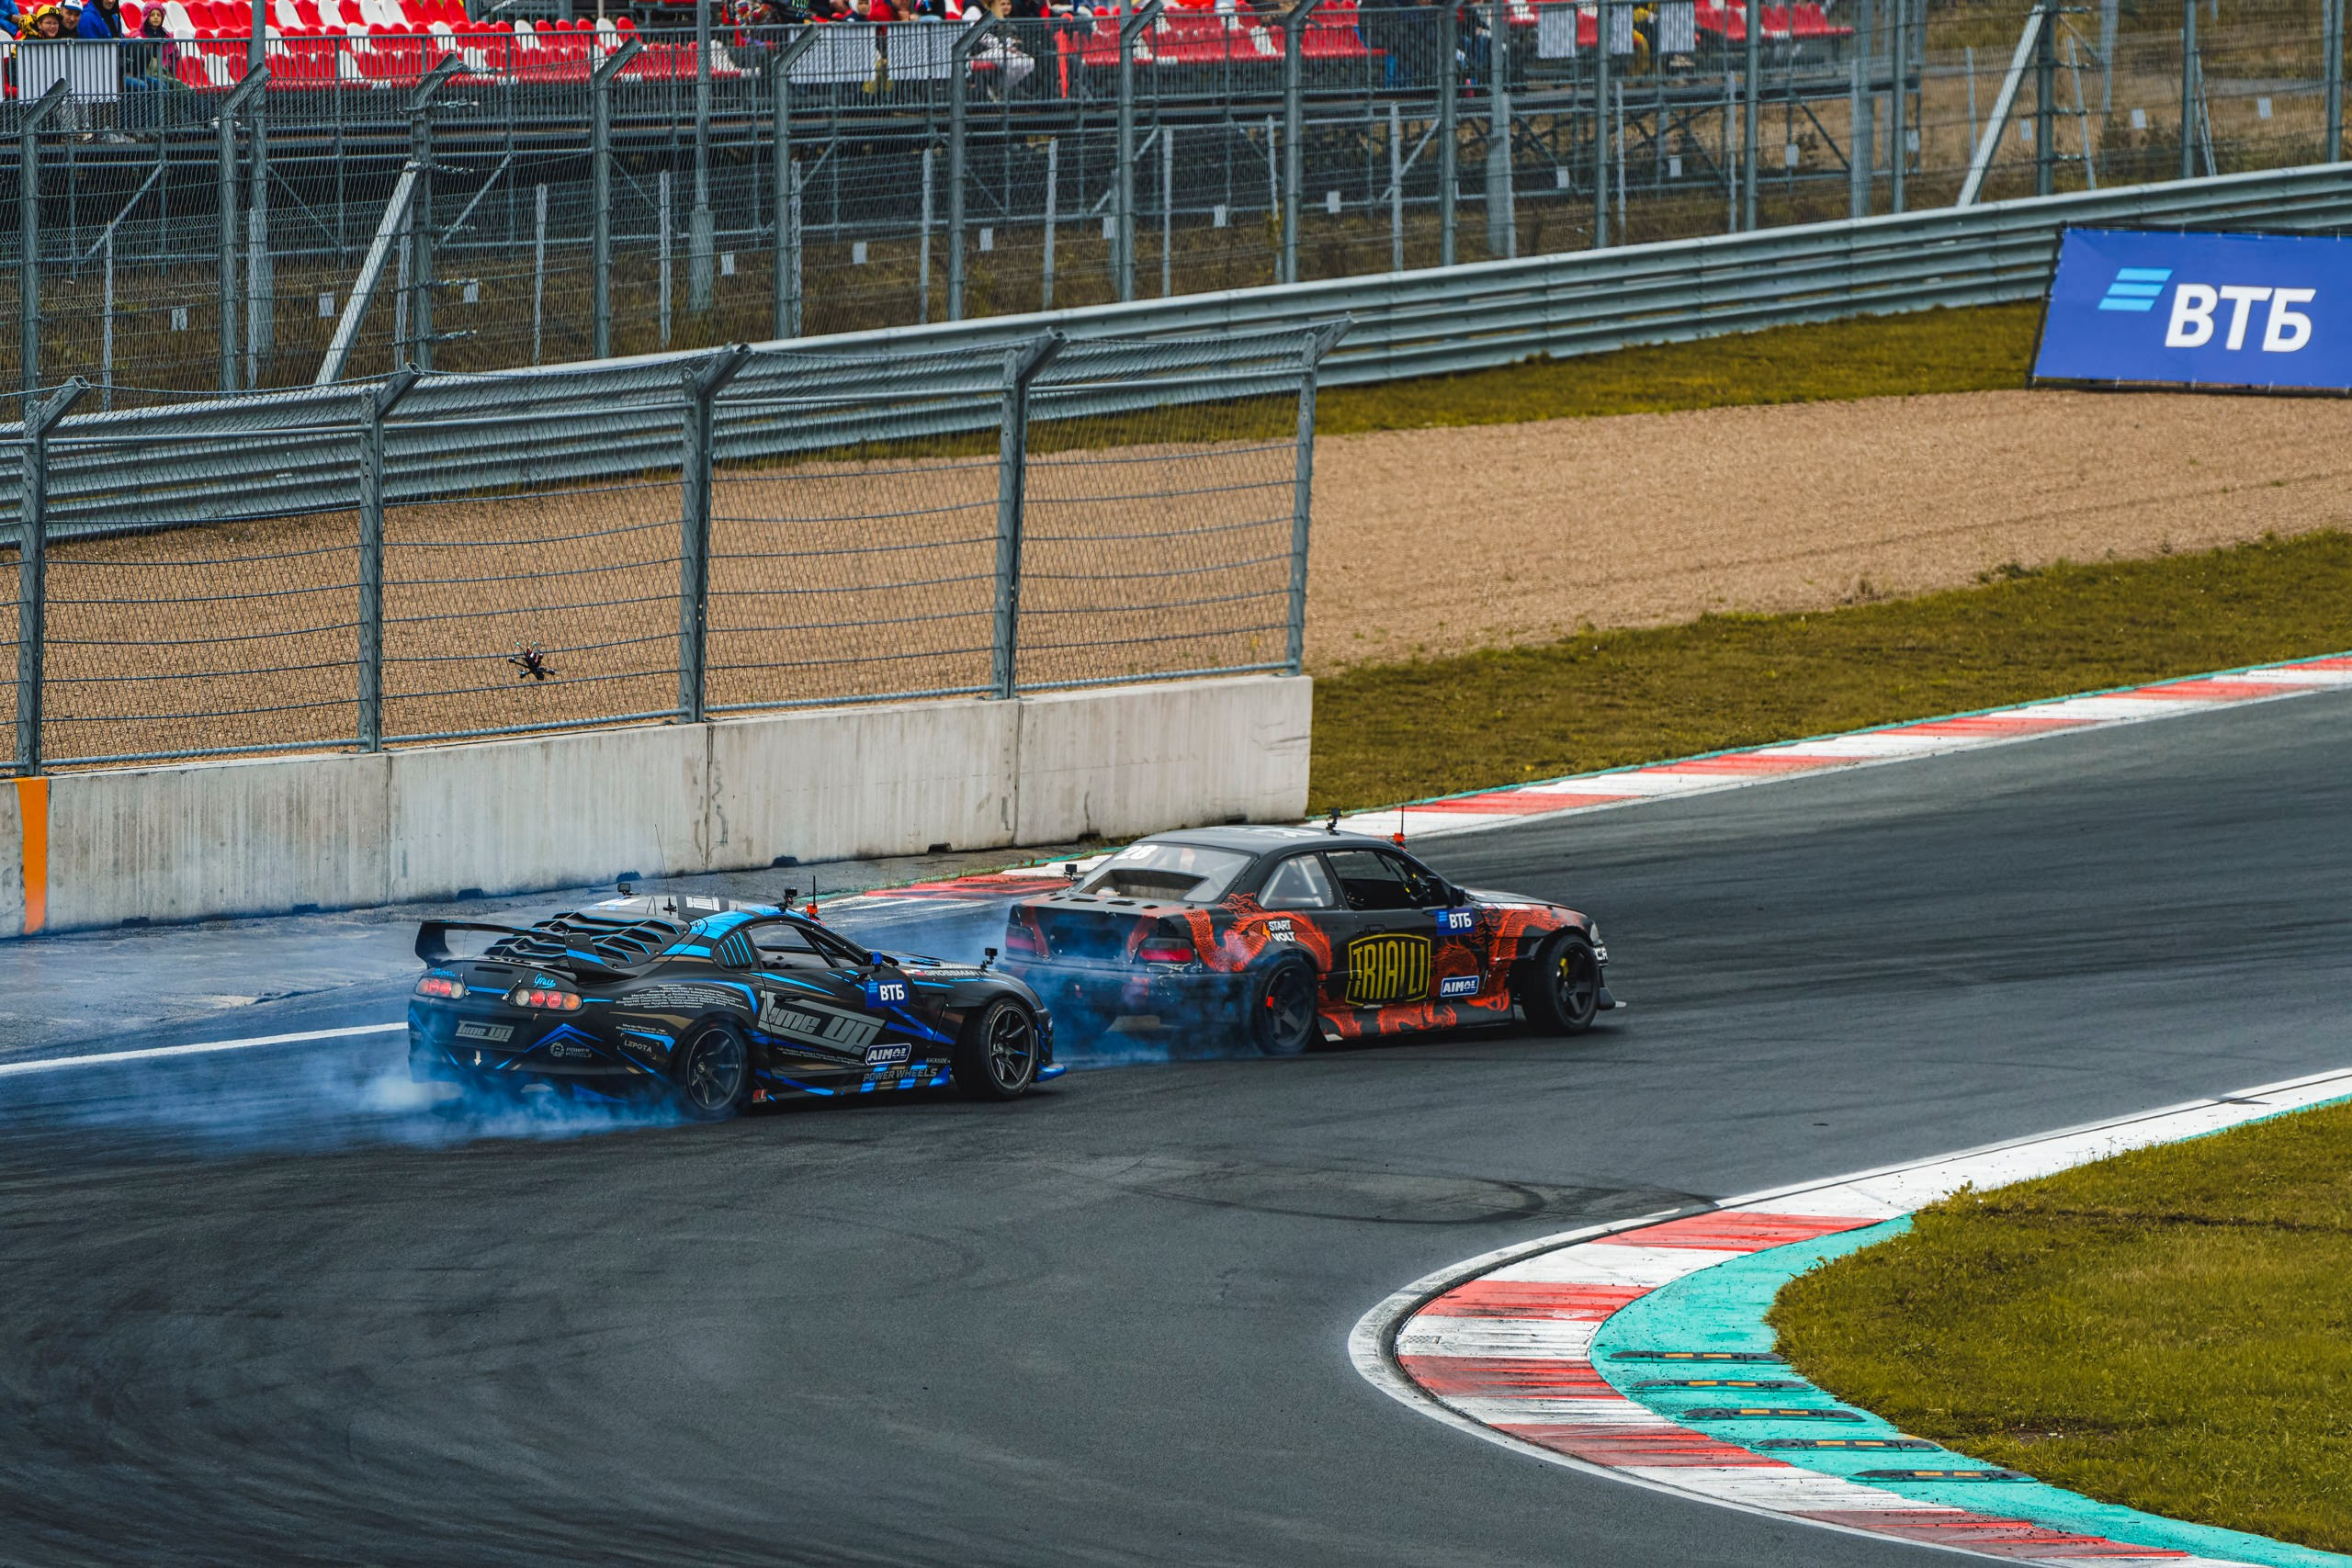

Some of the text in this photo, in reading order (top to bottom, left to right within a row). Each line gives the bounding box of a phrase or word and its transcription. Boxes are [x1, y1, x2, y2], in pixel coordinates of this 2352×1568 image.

[2165, 284, 2317, 353] ВТБ
[1268, 919, 1292, 931] START
[1449, 913, 1472, 929] ВТБ
[1271, 931, 1296, 942] VOLT
[879, 984, 905, 1001] ВТБ
[1442, 980, 1476, 993] AIMOL
[624, 1040, 652, 1053] LEPOTA
[867, 1048, 908, 1062] AIMOL
[863, 1068, 938, 1082] POWER WHEELS
